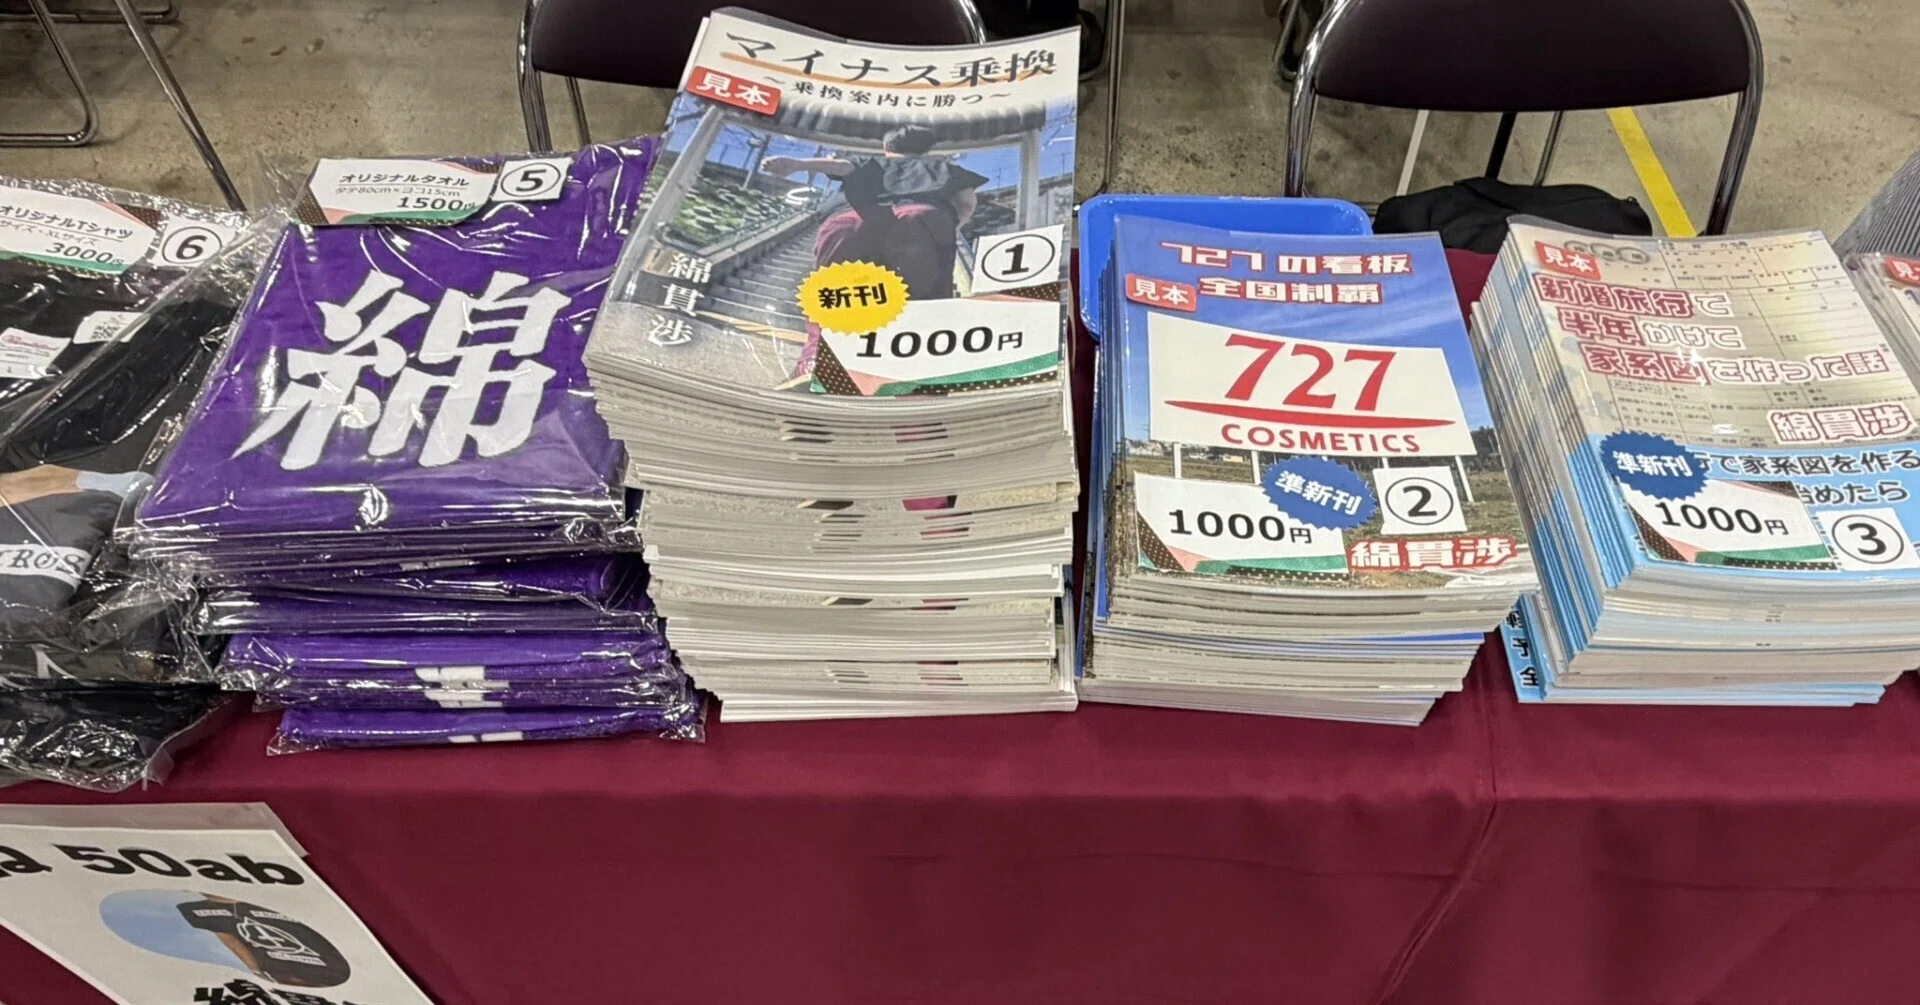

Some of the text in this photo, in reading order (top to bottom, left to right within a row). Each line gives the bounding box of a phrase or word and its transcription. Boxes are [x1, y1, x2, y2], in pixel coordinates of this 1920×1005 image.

[726, 32, 1057, 87] マイナス乗換
[695, 74, 770, 107] 見本
[338, 173, 469, 186] オリジナルタオル
[397, 196, 477, 211] 1500円
[0, 205, 133, 239] オリジナルTシャツ
[45, 242, 124, 265] 3000円
[1161, 242, 1412, 275] 727の看板
[1542, 245, 1594, 273] 見本
[1892, 260, 1920, 280] 見
[647, 252, 713, 349] 綿貫渉
[817, 283, 889, 309] 新刊
[1133, 280, 1190, 304] 見本
[1199, 277, 1383, 304] 全国制覇
[1535, 275, 1734, 318] 新婚旅行で
[856, 327, 1023, 358] 1000円
[1558, 307, 1745, 349] 半年かけて
[229, 269, 572, 471] 綿
[1225, 334, 1397, 411] 727
[1581, 345, 1889, 385] 家系図を作った話
[1221, 424, 1420, 453] COSMETICS
[1770, 404, 1913, 444] 綿貫渉
[1613, 452, 1693, 477] 準新刊
[1275, 470, 1364, 516] 準新刊
[1169, 510, 1313, 545] 1000円
[1655, 502, 1789, 536] 1000円
[1350, 538, 1516, 571] 綿貫渉
[51, 844, 305, 886] 50ab
